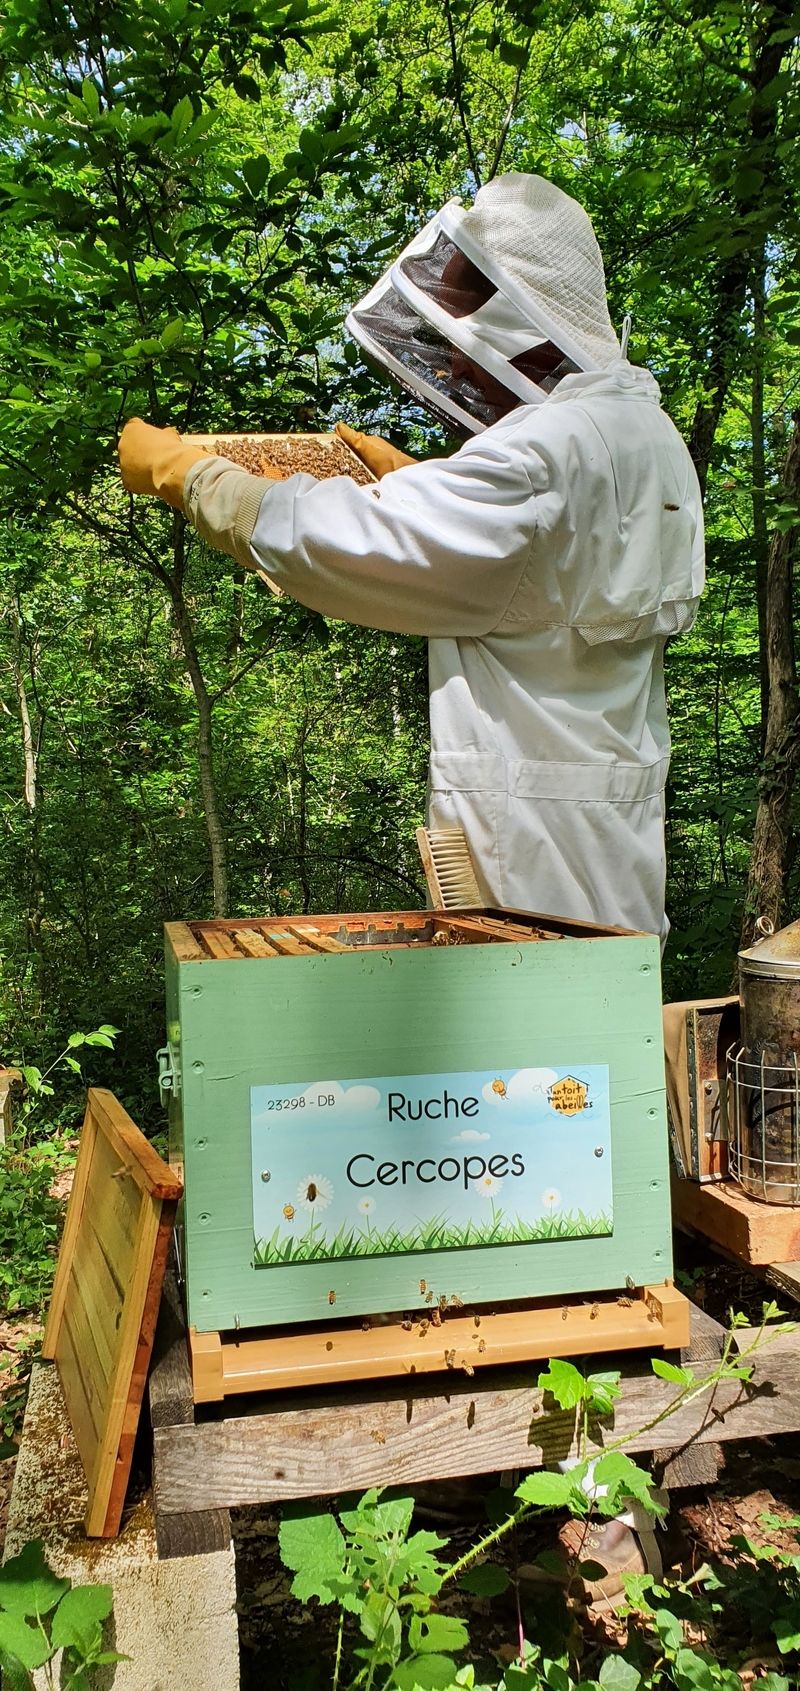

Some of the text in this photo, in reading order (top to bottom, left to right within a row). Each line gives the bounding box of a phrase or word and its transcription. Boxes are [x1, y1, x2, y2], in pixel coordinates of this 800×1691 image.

[562, 1083, 582, 1095] toit
[267, 1096, 306, 1112] 23298
[317, 1094, 336, 1107] DB
[388, 1090, 480, 1122] Ruche
[555, 1094, 593, 1110] abeilles
[346, 1153, 526, 1190] Cercopes
